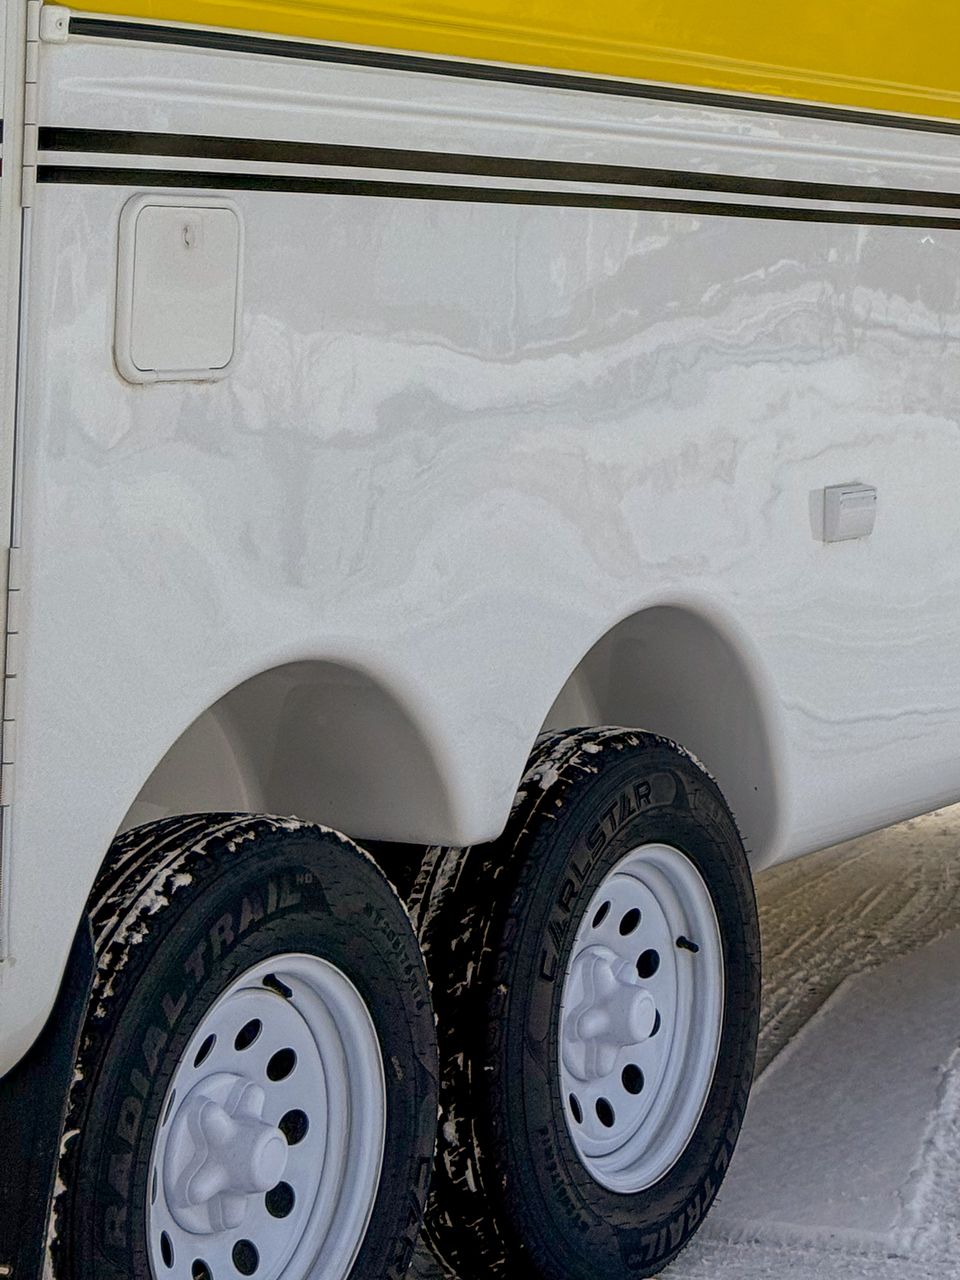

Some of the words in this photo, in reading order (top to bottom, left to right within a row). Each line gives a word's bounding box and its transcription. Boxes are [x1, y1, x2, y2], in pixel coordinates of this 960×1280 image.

[539, 780, 652, 983] CARLSTAR
[105, 991, 188, 1247] RADIAL
[184, 876, 300, 978] TRAIL
[641, 1177, 718, 1261] TRAIL
